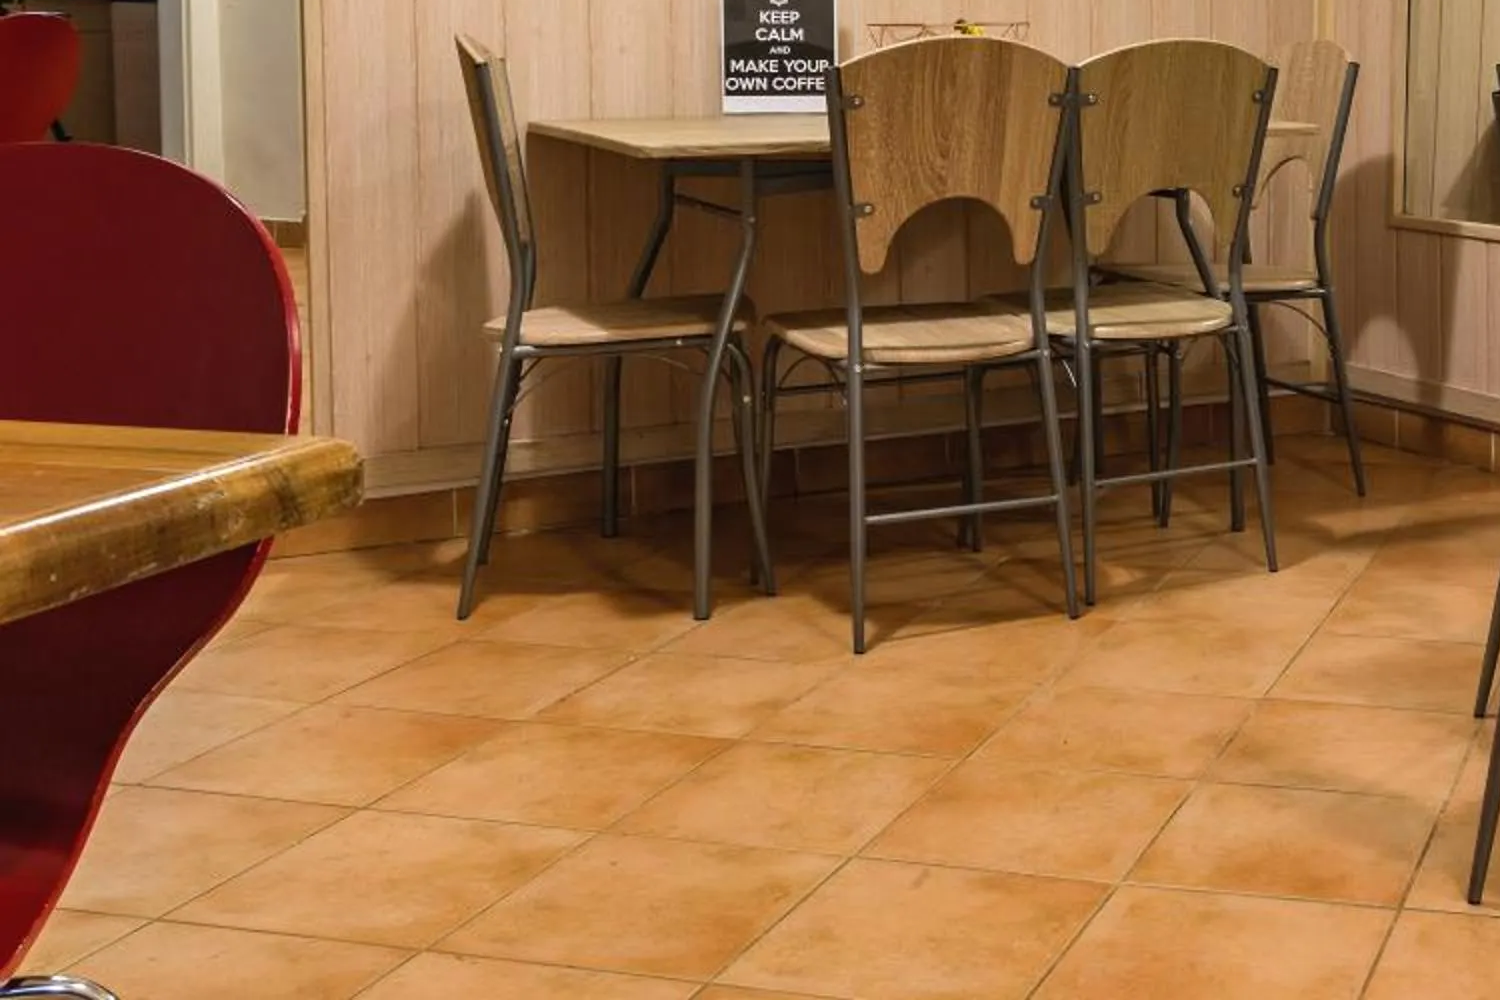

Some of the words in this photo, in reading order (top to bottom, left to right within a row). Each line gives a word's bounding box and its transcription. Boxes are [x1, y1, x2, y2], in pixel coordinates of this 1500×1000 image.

[759, 10, 801, 24] KEEP
[755, 27, 804, 41] CALM
[769, 45, 791, 54] AND
[730, 59, 778, 73] MAKE
[725, 77, 768, 91] OWN
[772, 77, 825, 91] COFFE
